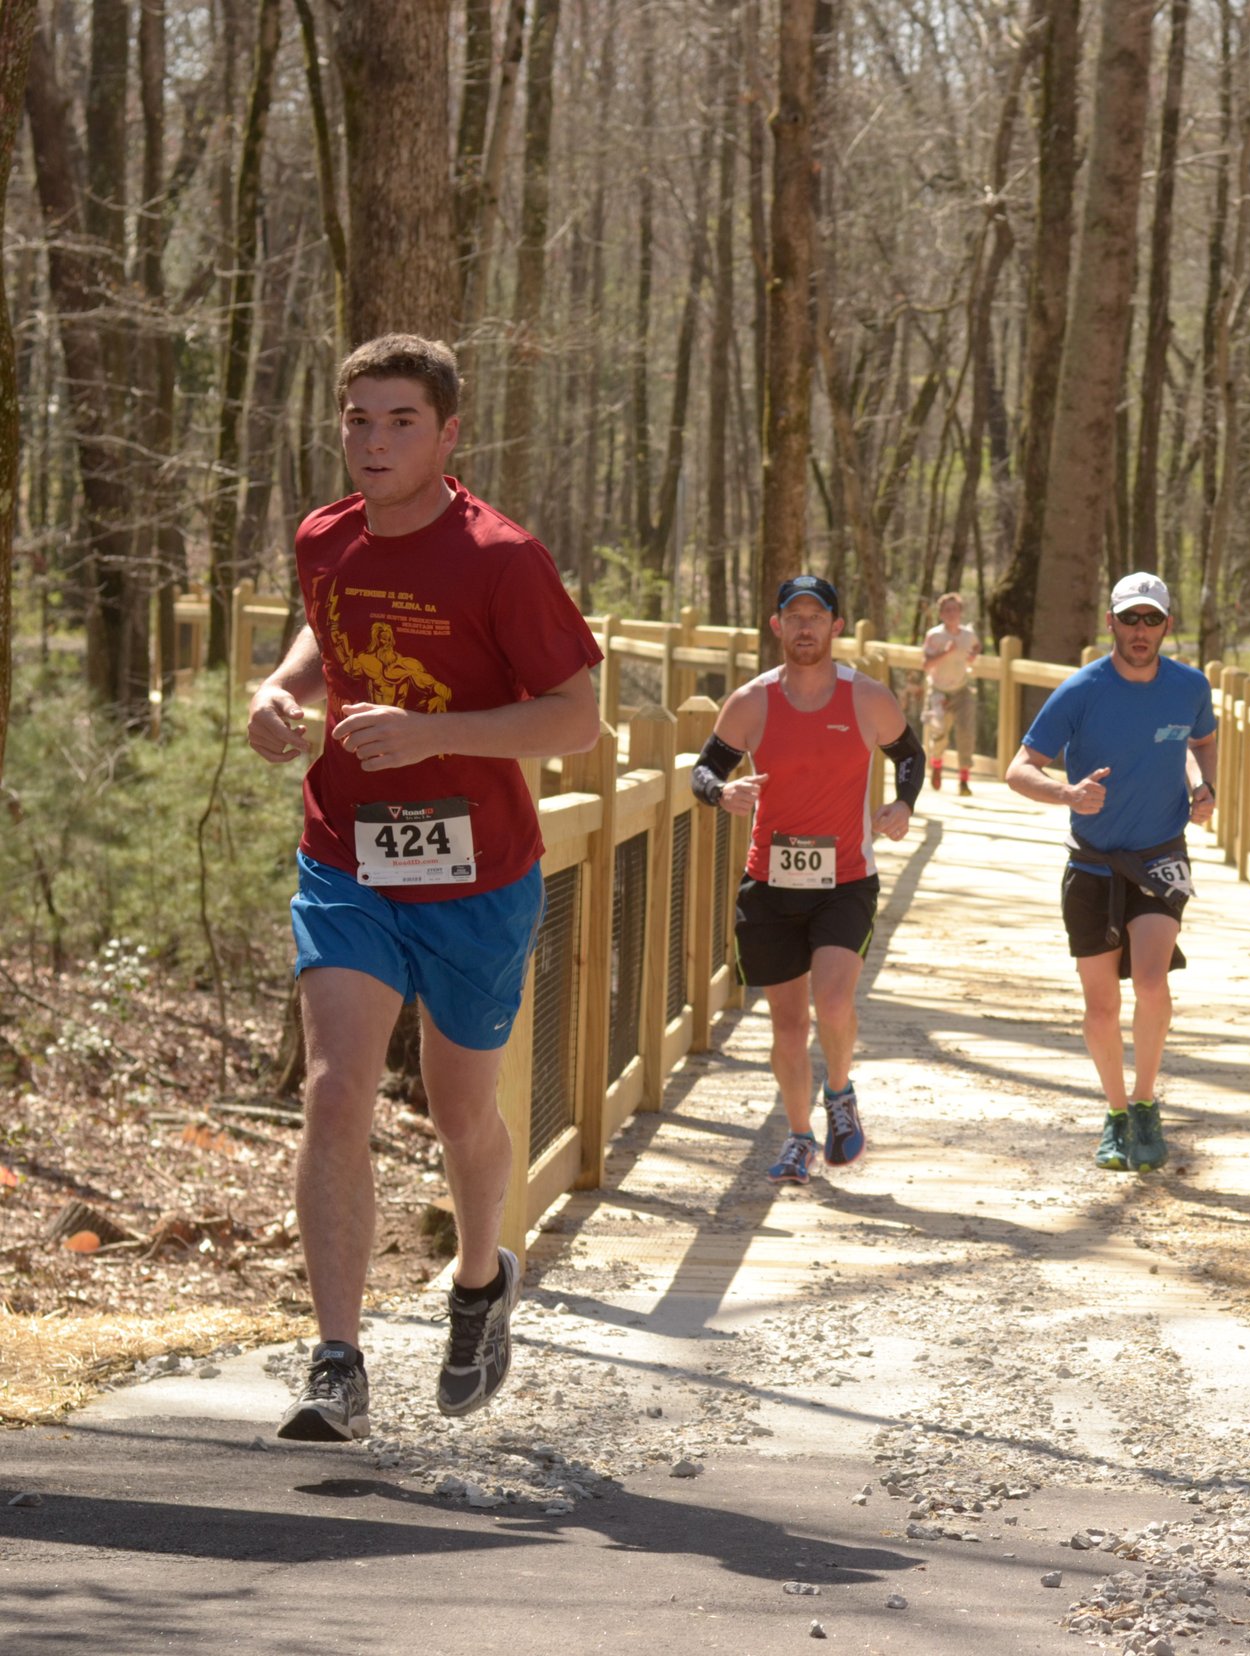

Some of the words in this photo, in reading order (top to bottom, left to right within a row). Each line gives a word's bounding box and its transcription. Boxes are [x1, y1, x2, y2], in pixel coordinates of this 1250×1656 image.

[425, 604, 437, 613] GA
[374, 822, 451, 858] 424
[780, 850, 822, 871] 360
